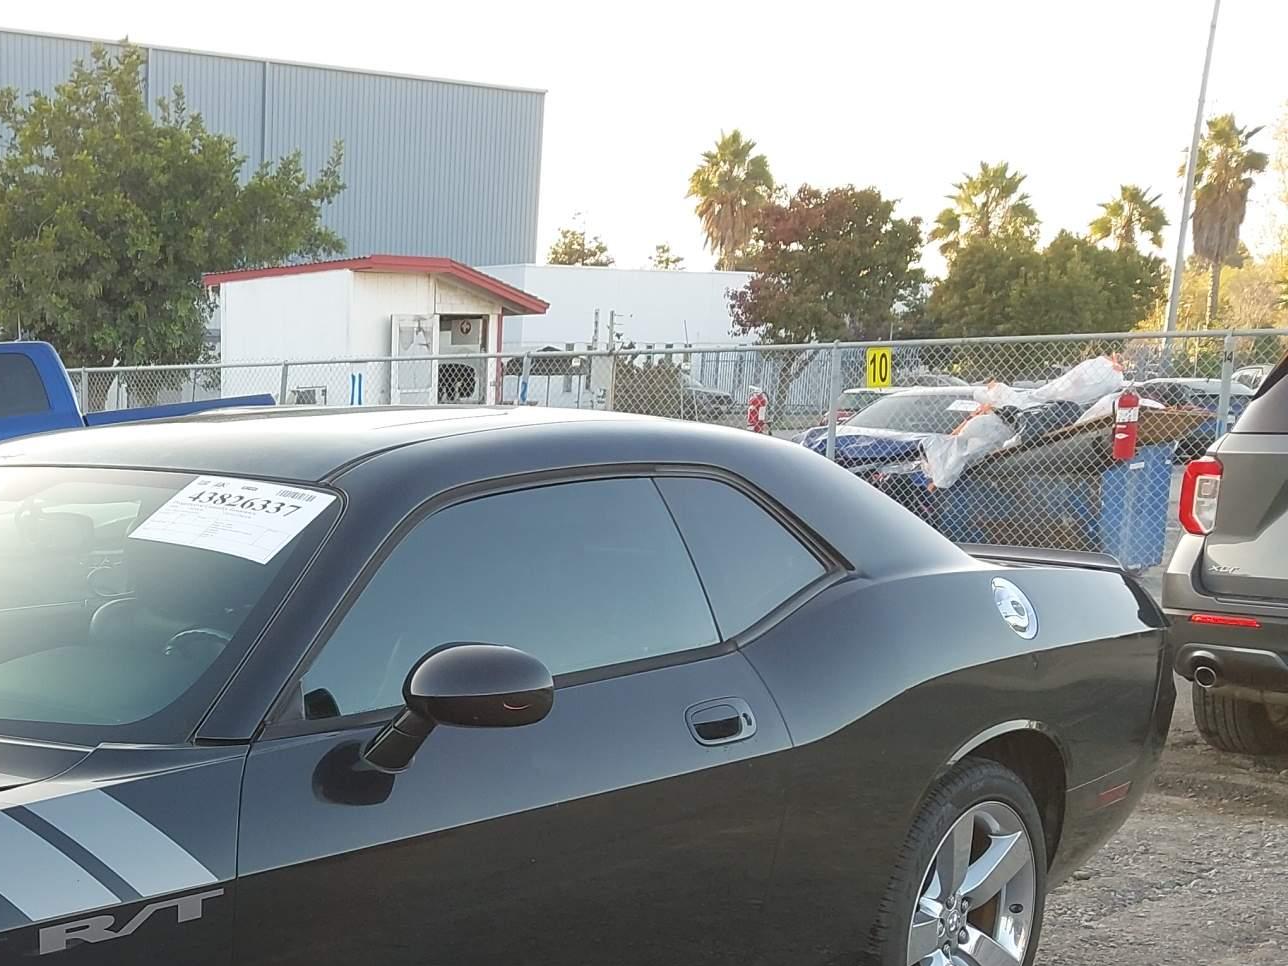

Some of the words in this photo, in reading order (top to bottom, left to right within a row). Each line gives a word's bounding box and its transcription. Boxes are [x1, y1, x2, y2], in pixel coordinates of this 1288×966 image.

[869, 352, 888, 383] 10
[188, 490, 302, 518] 43826337
[39, 888, 225, 956] R/T
